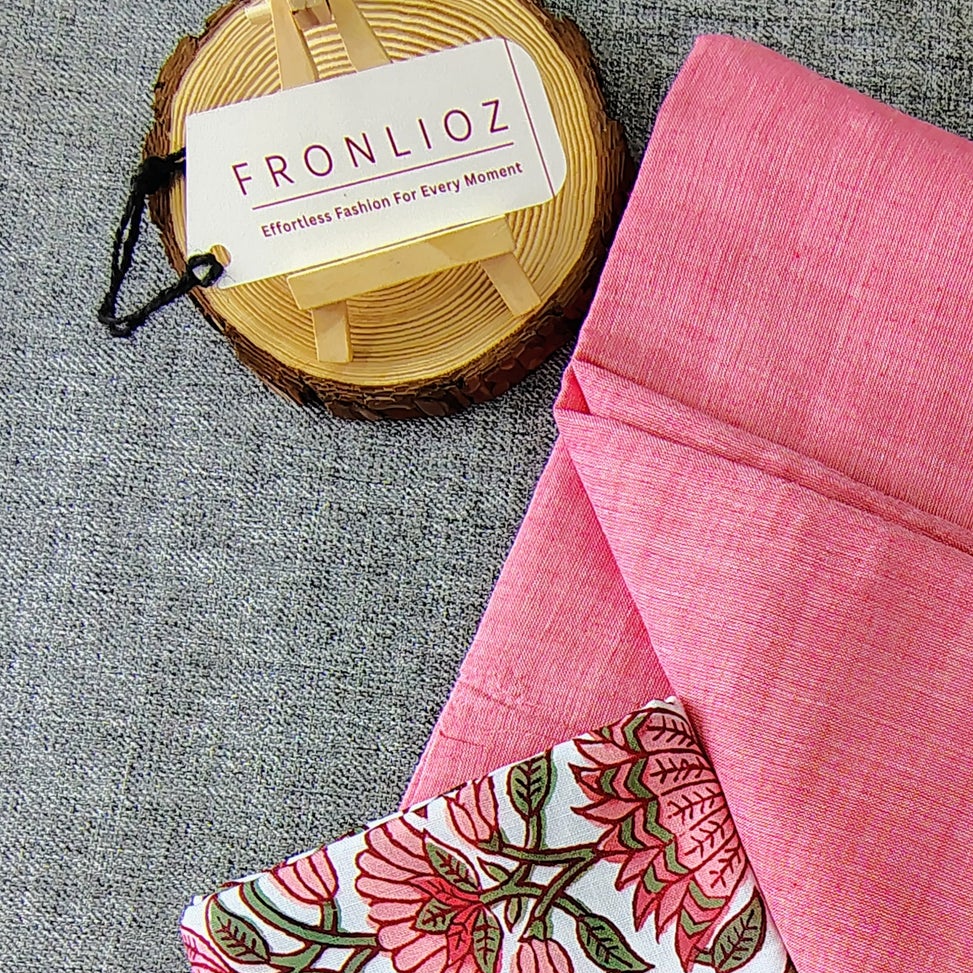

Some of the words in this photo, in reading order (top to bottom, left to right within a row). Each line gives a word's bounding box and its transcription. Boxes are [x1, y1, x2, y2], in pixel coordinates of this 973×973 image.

[232, 99, 509, 196] FRONLIOZ
[261, 211, 332, 238] Effortless
[335, 197, 391, 220] Fashion
[393, 188, 418, 205] For
[421, 177, 461, 200] Every
[465, 161, 523, 187] Moment
